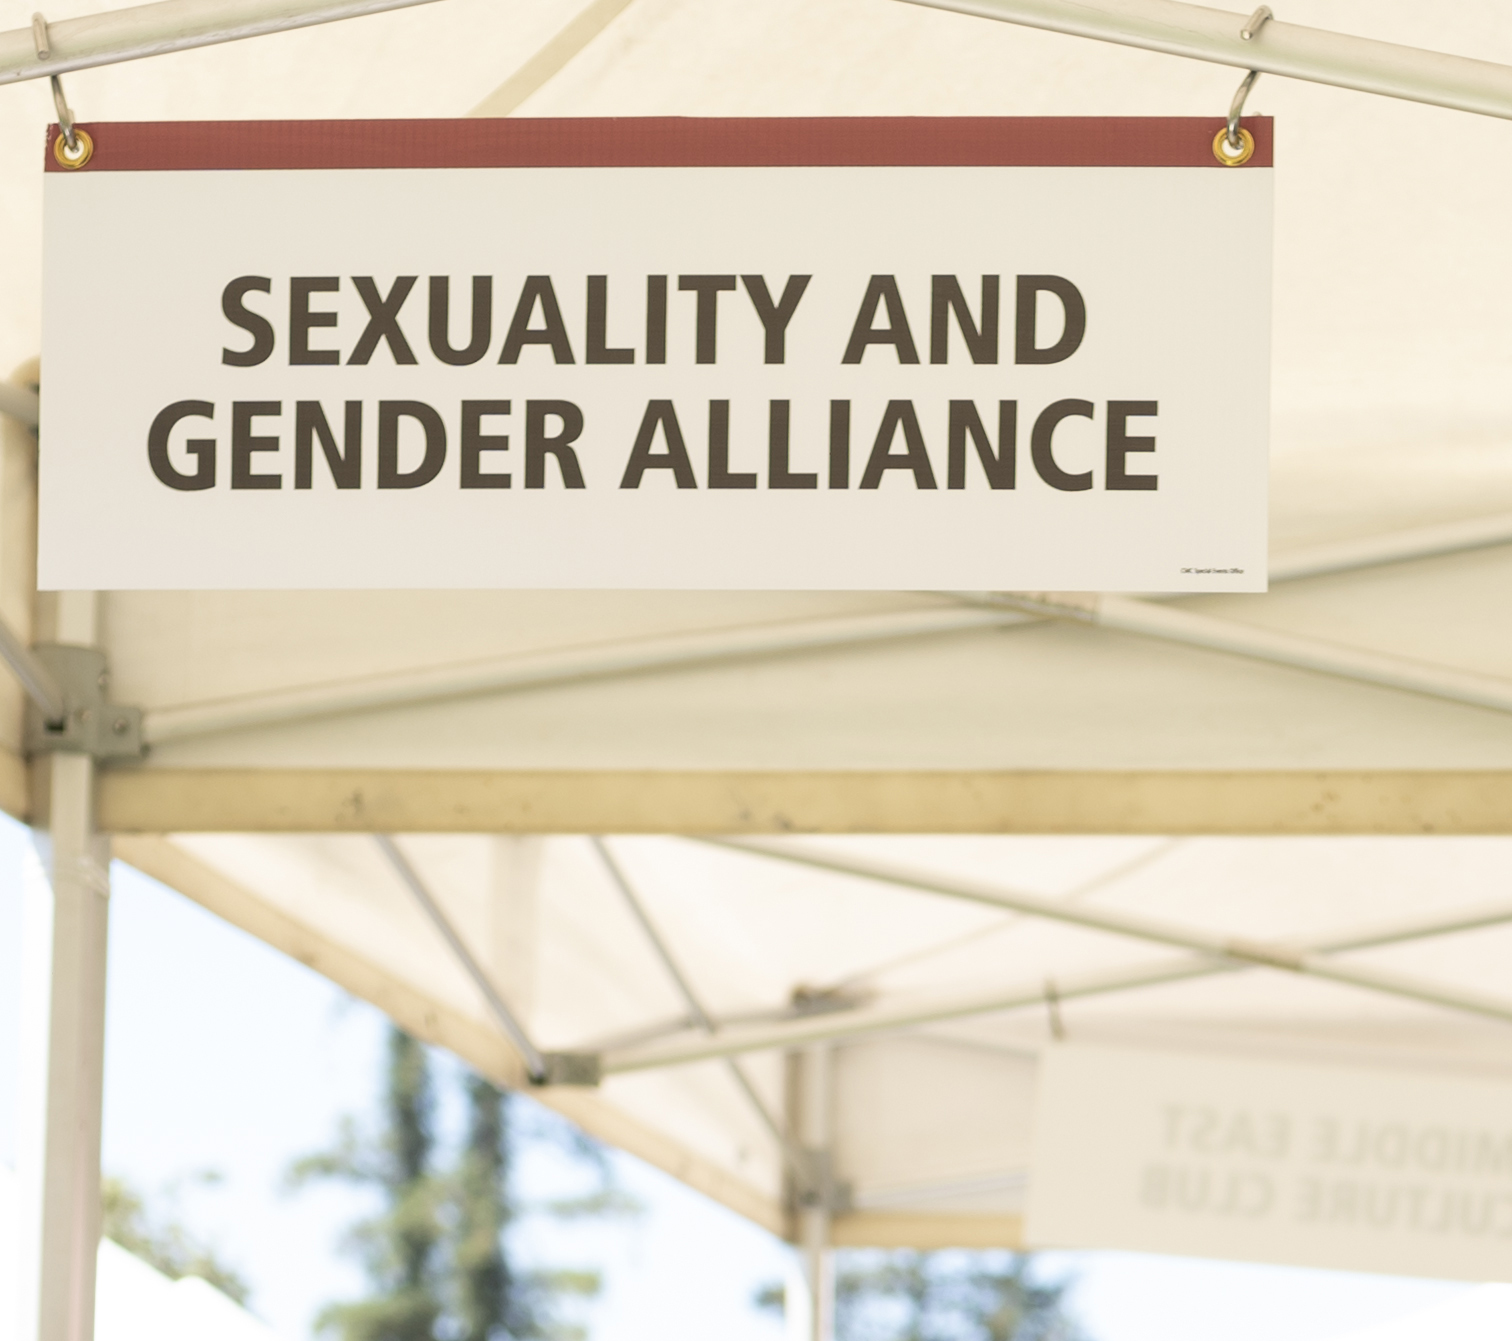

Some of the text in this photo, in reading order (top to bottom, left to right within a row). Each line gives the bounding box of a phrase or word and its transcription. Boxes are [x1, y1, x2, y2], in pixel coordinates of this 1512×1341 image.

[222, 275, 1086, 367] SEXUALITY AND
[148, 399, 1157, 491] GENDER ALLIANCE
